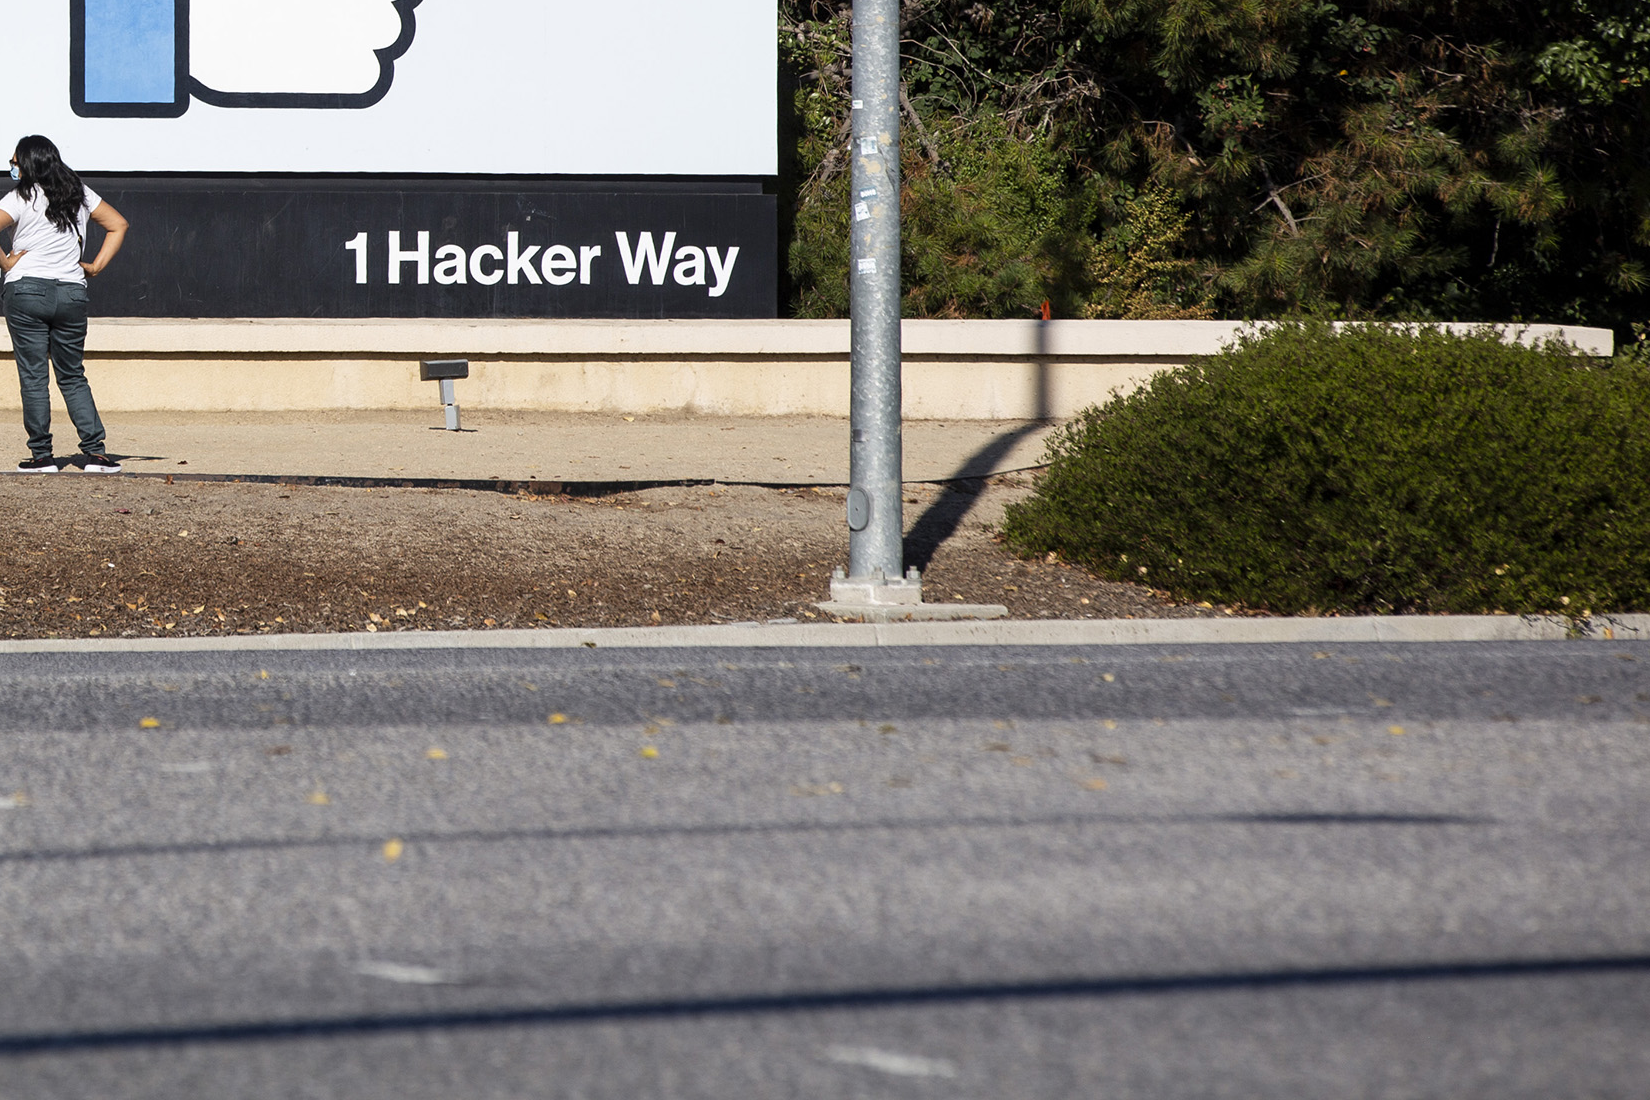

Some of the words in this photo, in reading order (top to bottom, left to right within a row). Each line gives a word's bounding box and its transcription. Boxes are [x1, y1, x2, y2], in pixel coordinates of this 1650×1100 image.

[344, 231, 368, 285] 1
[387, 230, 602, 286] Hacker
[614, 231, 740, 298] Way
